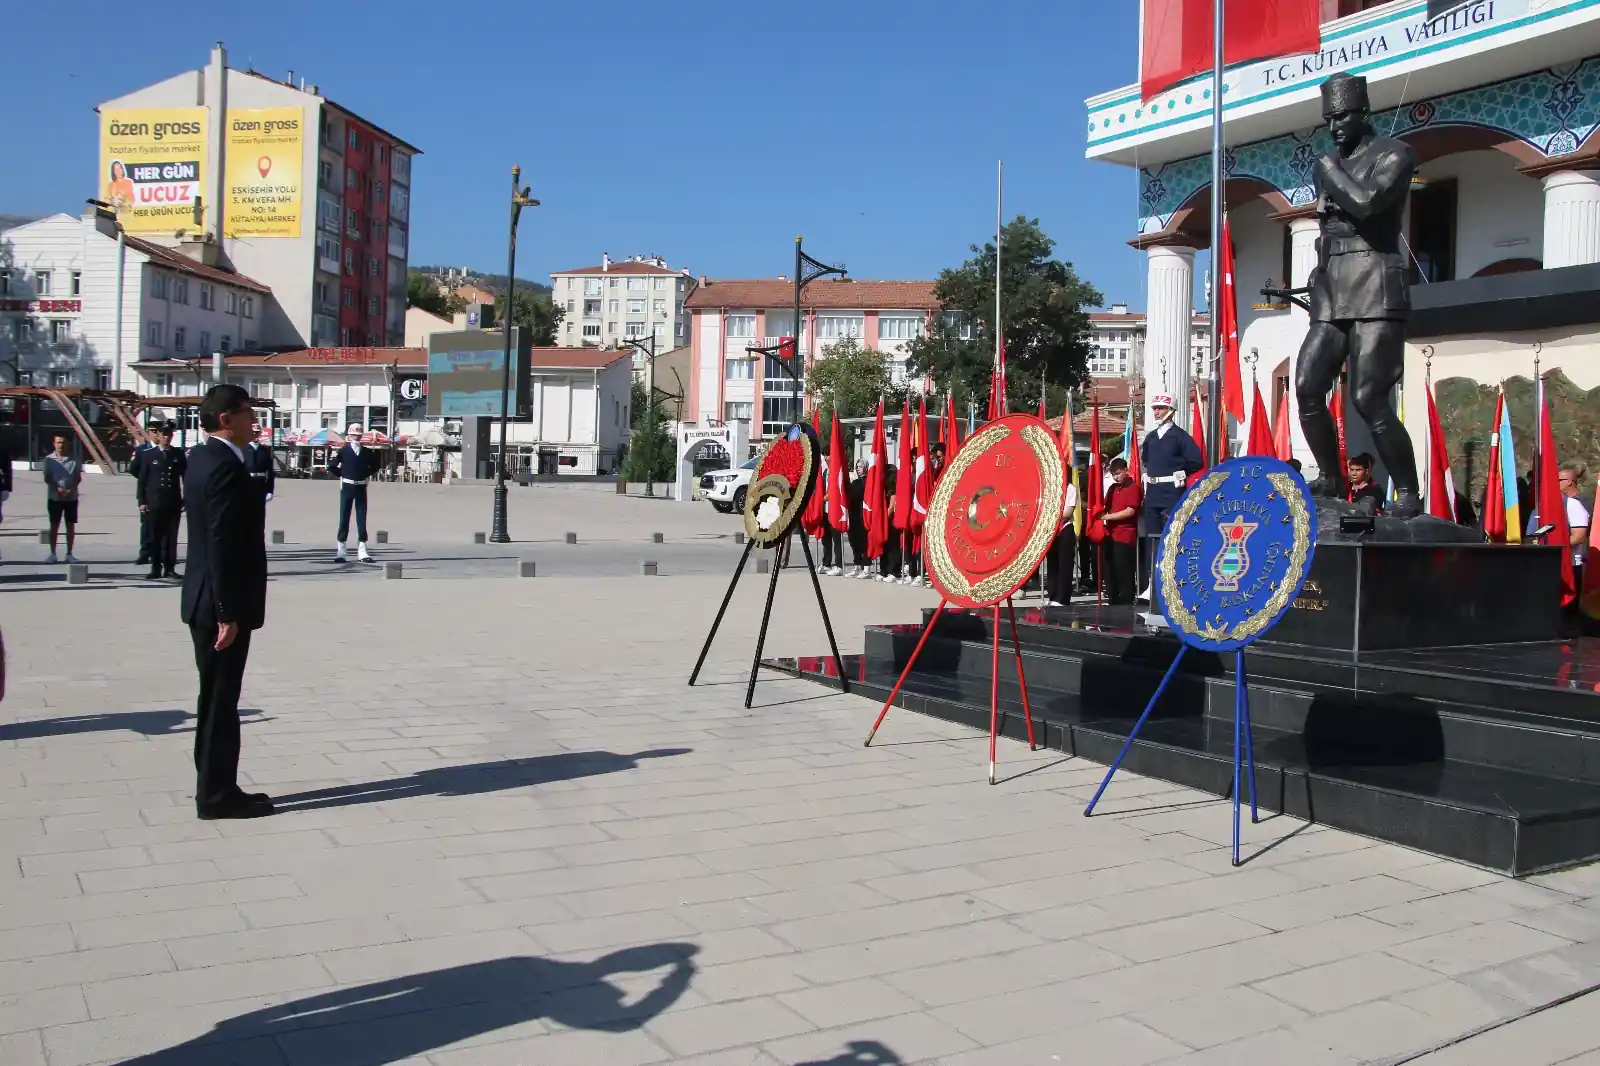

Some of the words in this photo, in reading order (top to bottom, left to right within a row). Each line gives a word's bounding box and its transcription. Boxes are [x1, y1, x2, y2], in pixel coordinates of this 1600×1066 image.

[1262, 64, 1295, 86] T.C.
[1302, 35, 1389, 76] KÜTAHYA
[110, 120, 148, 136] özen
[153, 121, 200, 140] gross
[232, 119, 260, 131] özen
[263, 119, 298, 134] gross
[109, 145, 137, 155] toptan
[171, 143, 201, 153] market
[134, 166, 160, 180] HER
[162, 163, 194, 179] GÜN
[140, 185, 190, 203] UCUZ
[275, 185, 297, 194] YOLU
[241, 196, 254, 204] KM
[255, 195, 277, 204] VEFA
[134, 208, 149, 217] HER
[151, 206, 174, 217] ÜRÜN
[251, 206, 266, 214] NO:
